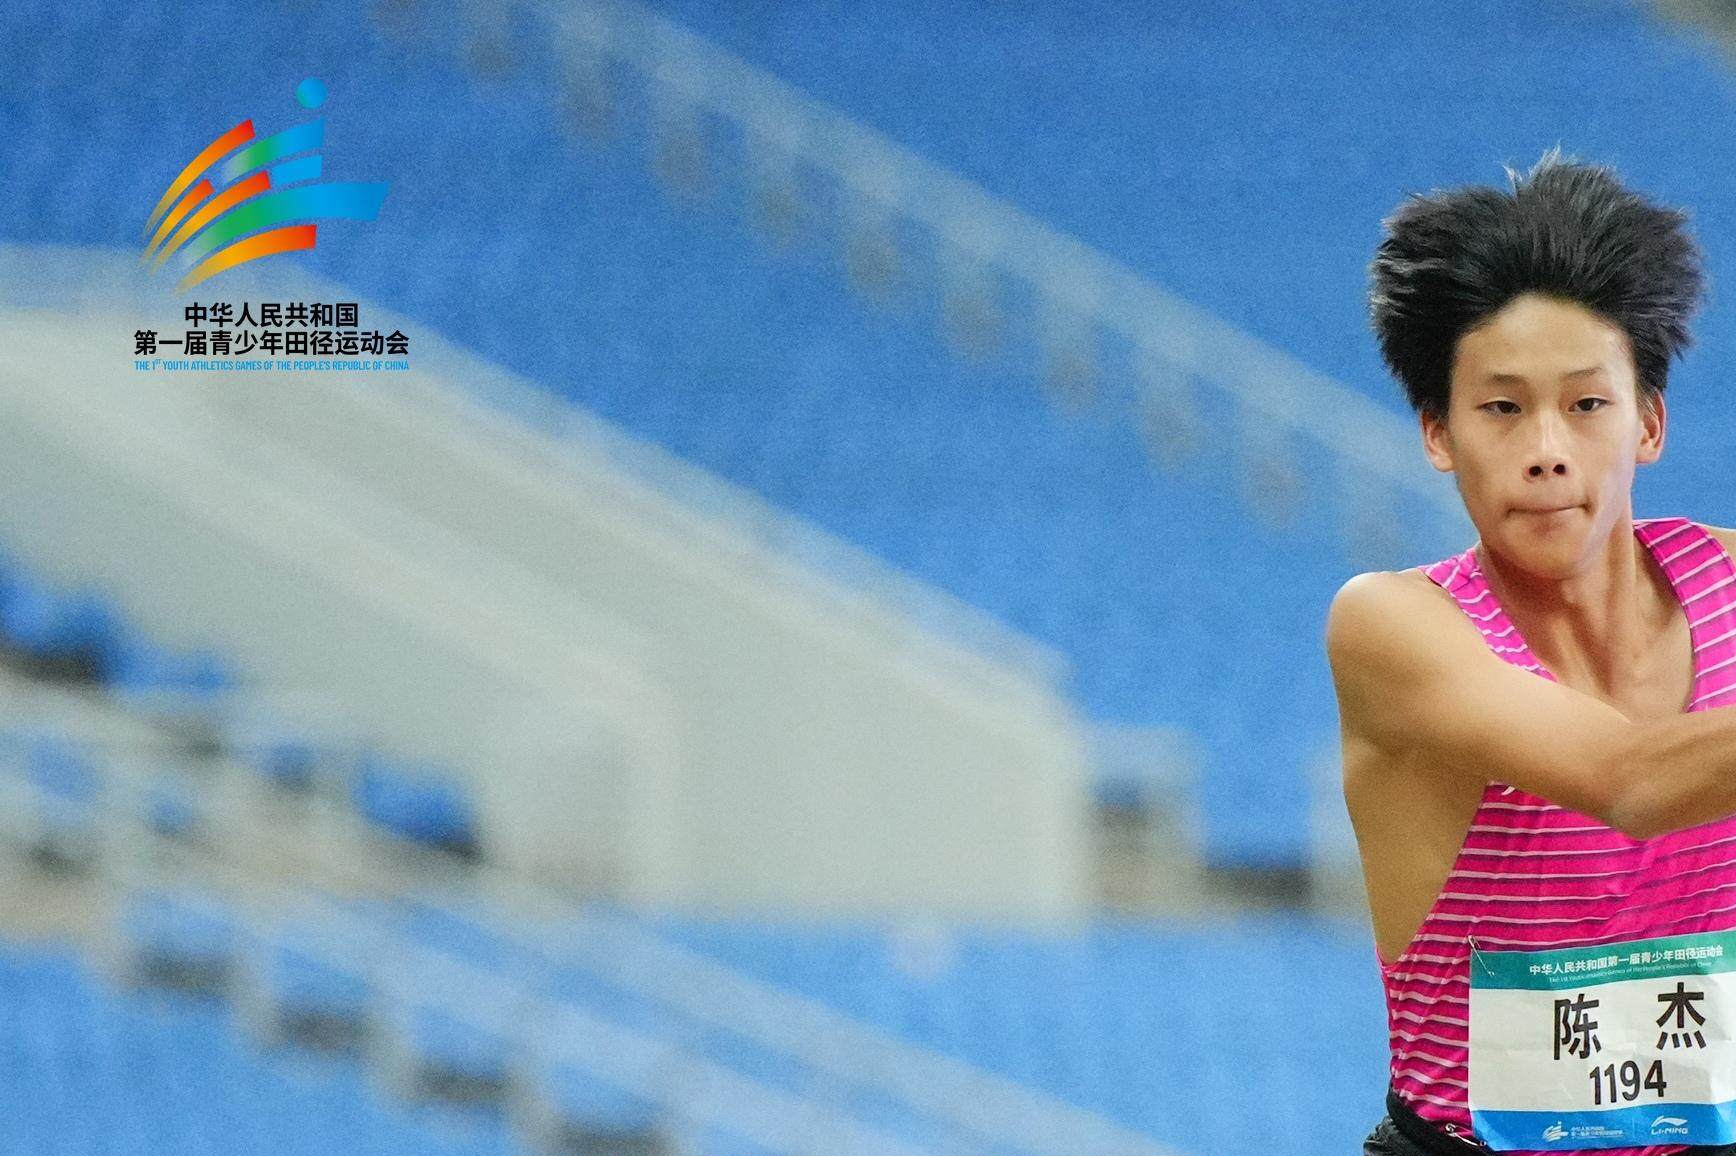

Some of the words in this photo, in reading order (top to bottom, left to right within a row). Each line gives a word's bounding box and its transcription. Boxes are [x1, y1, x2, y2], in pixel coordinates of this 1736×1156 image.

[1529, 944, 1724, 975] 中华人民共和国第一届青少年田径运动会
[1553, 993, 1602, 1061] 陈
[1656, 982, 1706, 1051] 杰
[1589, 1060, 1667, 1105] 1194
